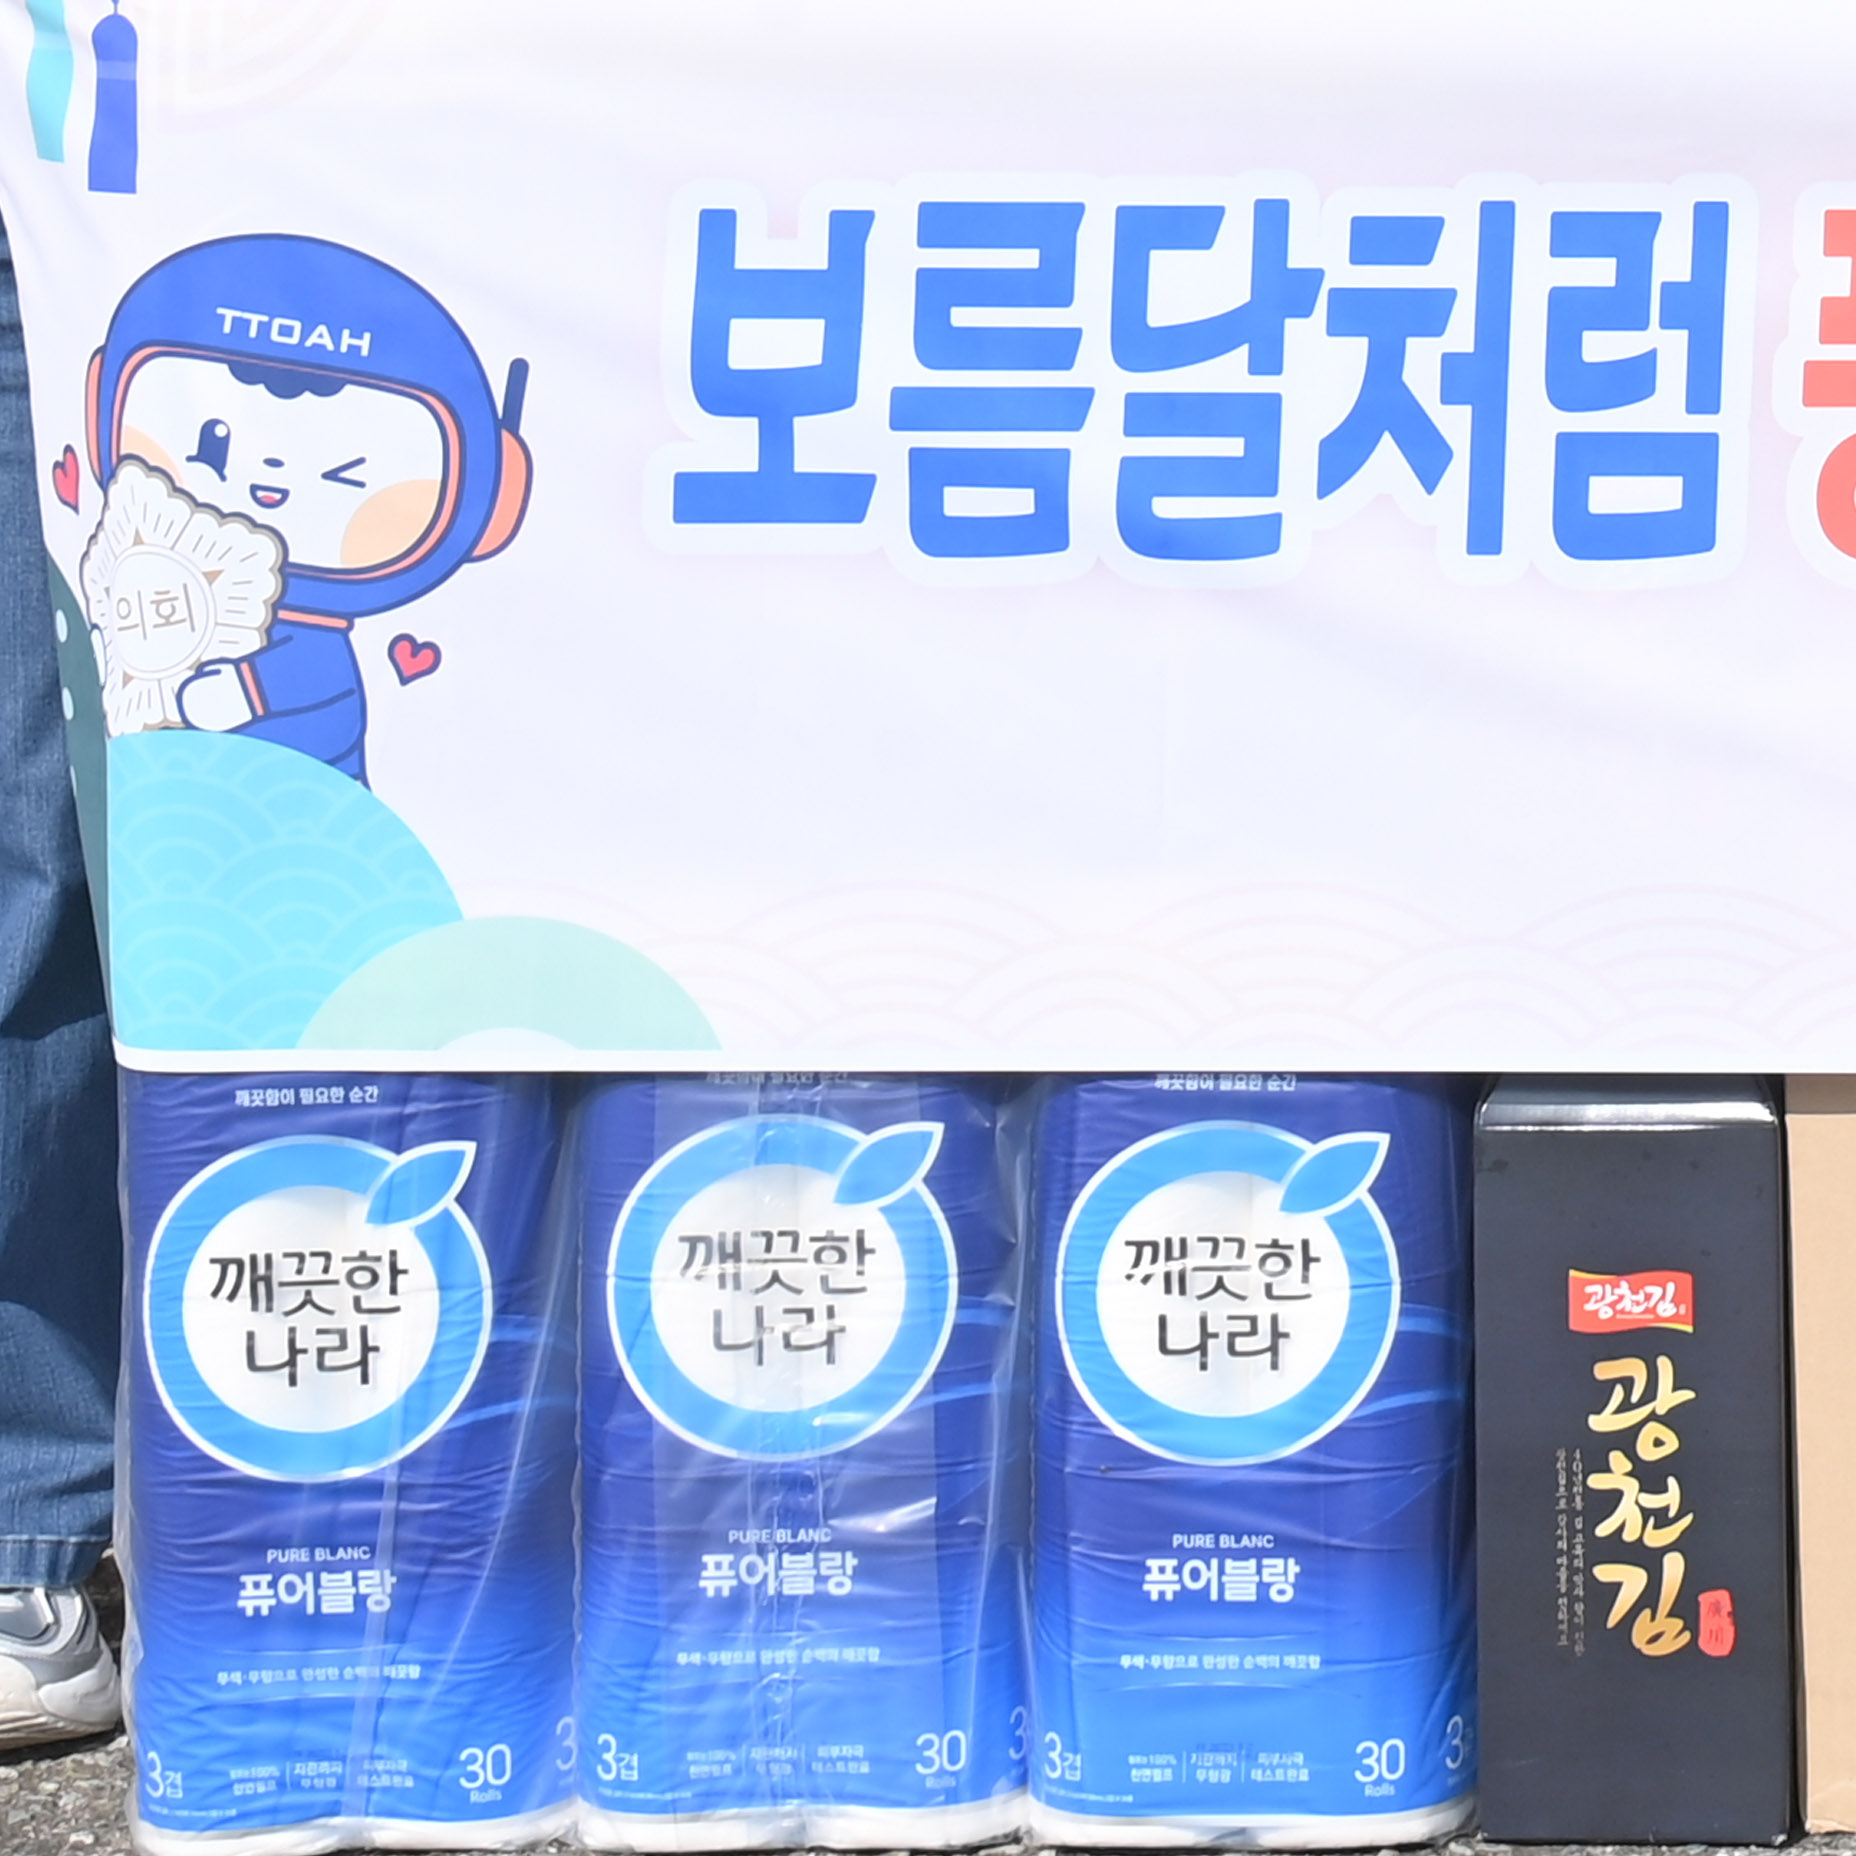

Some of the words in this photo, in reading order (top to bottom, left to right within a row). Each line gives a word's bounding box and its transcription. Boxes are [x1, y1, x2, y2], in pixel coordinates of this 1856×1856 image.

[216, 307, 372, 358] TTOAH
[671, 197, 1731, 564] 보름달처럼
[114, 582, 196, 641] 의회
[209, 1248, 409, 1318] 깨끗한
[677, 1228, 876, 1295] 깨끗한
[1124, 1234, 1321, 1301] 깨끗한
[1583, 1280, 1678, 1319] 광천김
[245, 1324, 381, 1388] 나라
[712, 1303, 846, 1366] 나라
[1157, 1313, 1290, 1372] 나라
[1588, 1355, 1697, 1656] 광천김
[266, 1547, 311, 1564] PURE
[314, 1545, 372, 1563] BLANC
[728, 1529, 773, 1545] PURE
[775, 1527, 833, 1544] BLANC
[1172, 1533, 1215, 1549] PURE
[1219, 1533, 1274, 1549] BLANC
[236, 1571, 397, 1617] 퓨어블랑
[698, 1550, 858, 1598] 퓨어블랑
[1141, 1557, 1301, 1604] 퓨어블랑
[145, 1750, 183, 1799] 3겹
[458, 1743, 513, 1789] 30
[596, 1733, 639, 1781] 3겹
[915, 1730, 967, 1775] 30
[1043, 1731, 1082, 1781] 3겹
[1354, 1738, 1405, 1782] 30
[469, 1788, 502, 1803] Rolls
[926, 1775, 956, 1789] Rolls
[1364, 1782, 1395, 1797] Rolls
